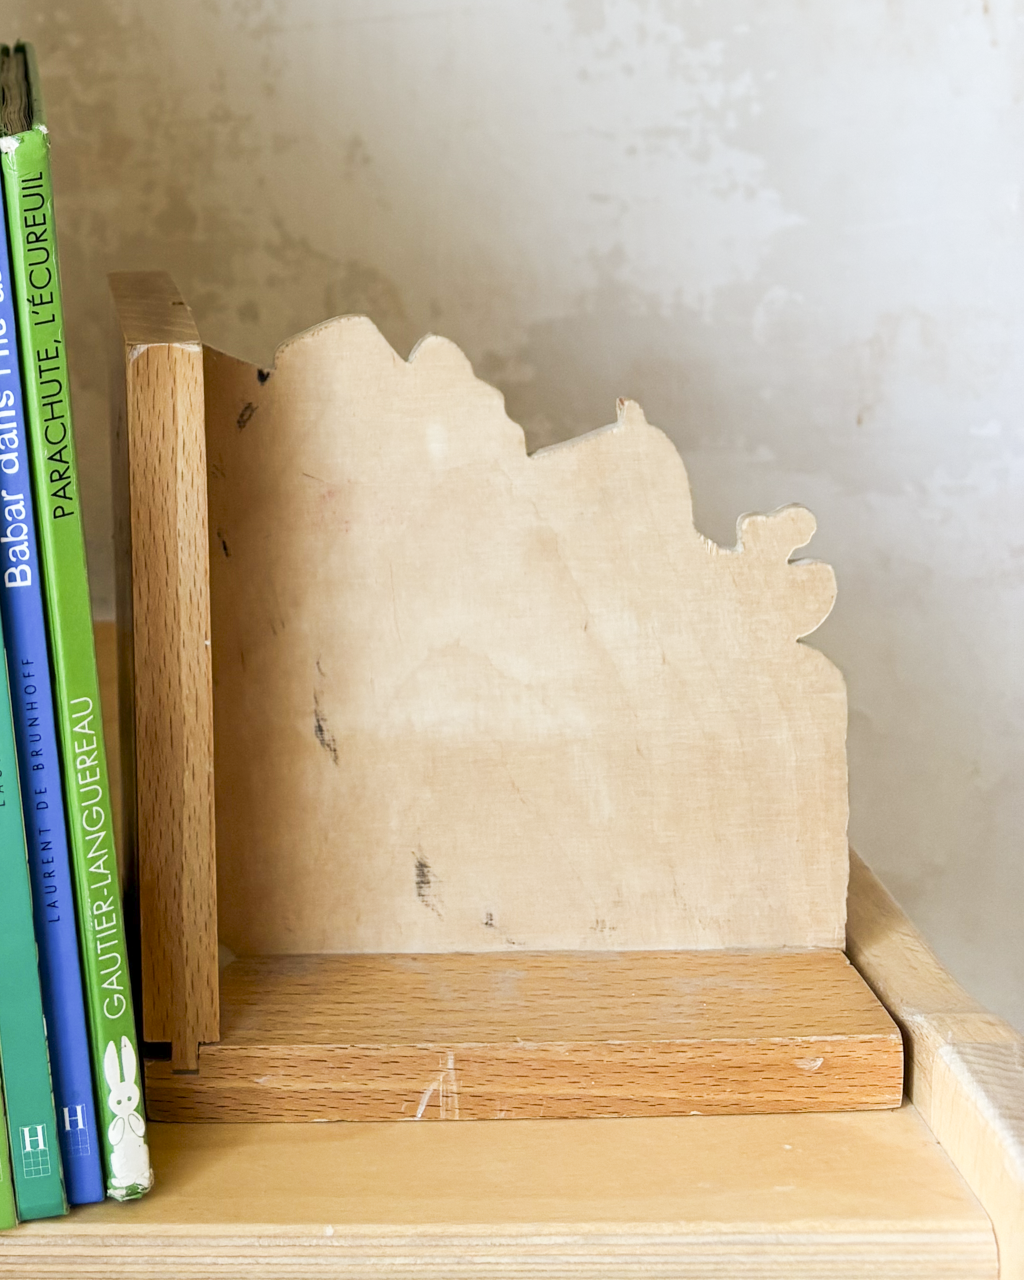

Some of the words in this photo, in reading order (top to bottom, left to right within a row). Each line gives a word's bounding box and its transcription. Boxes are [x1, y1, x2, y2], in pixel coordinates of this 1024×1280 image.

[22, 171, 56, 326] L'ÉCUREUIL
[37, 339, 75, 520] PARACHUTE,
[0, 489, 32, 588] Babar
[21, 658, 45, 771] BRUNHOFF
[34, 786, 49, 810] DE
[38, 827, 61, 923] LAURENT
[70, 696, 127, 1020] GAUTIER-LANGUEREAU
[23, 1125, 46, 1152] H
[63, 1104, 86, 1131] H
